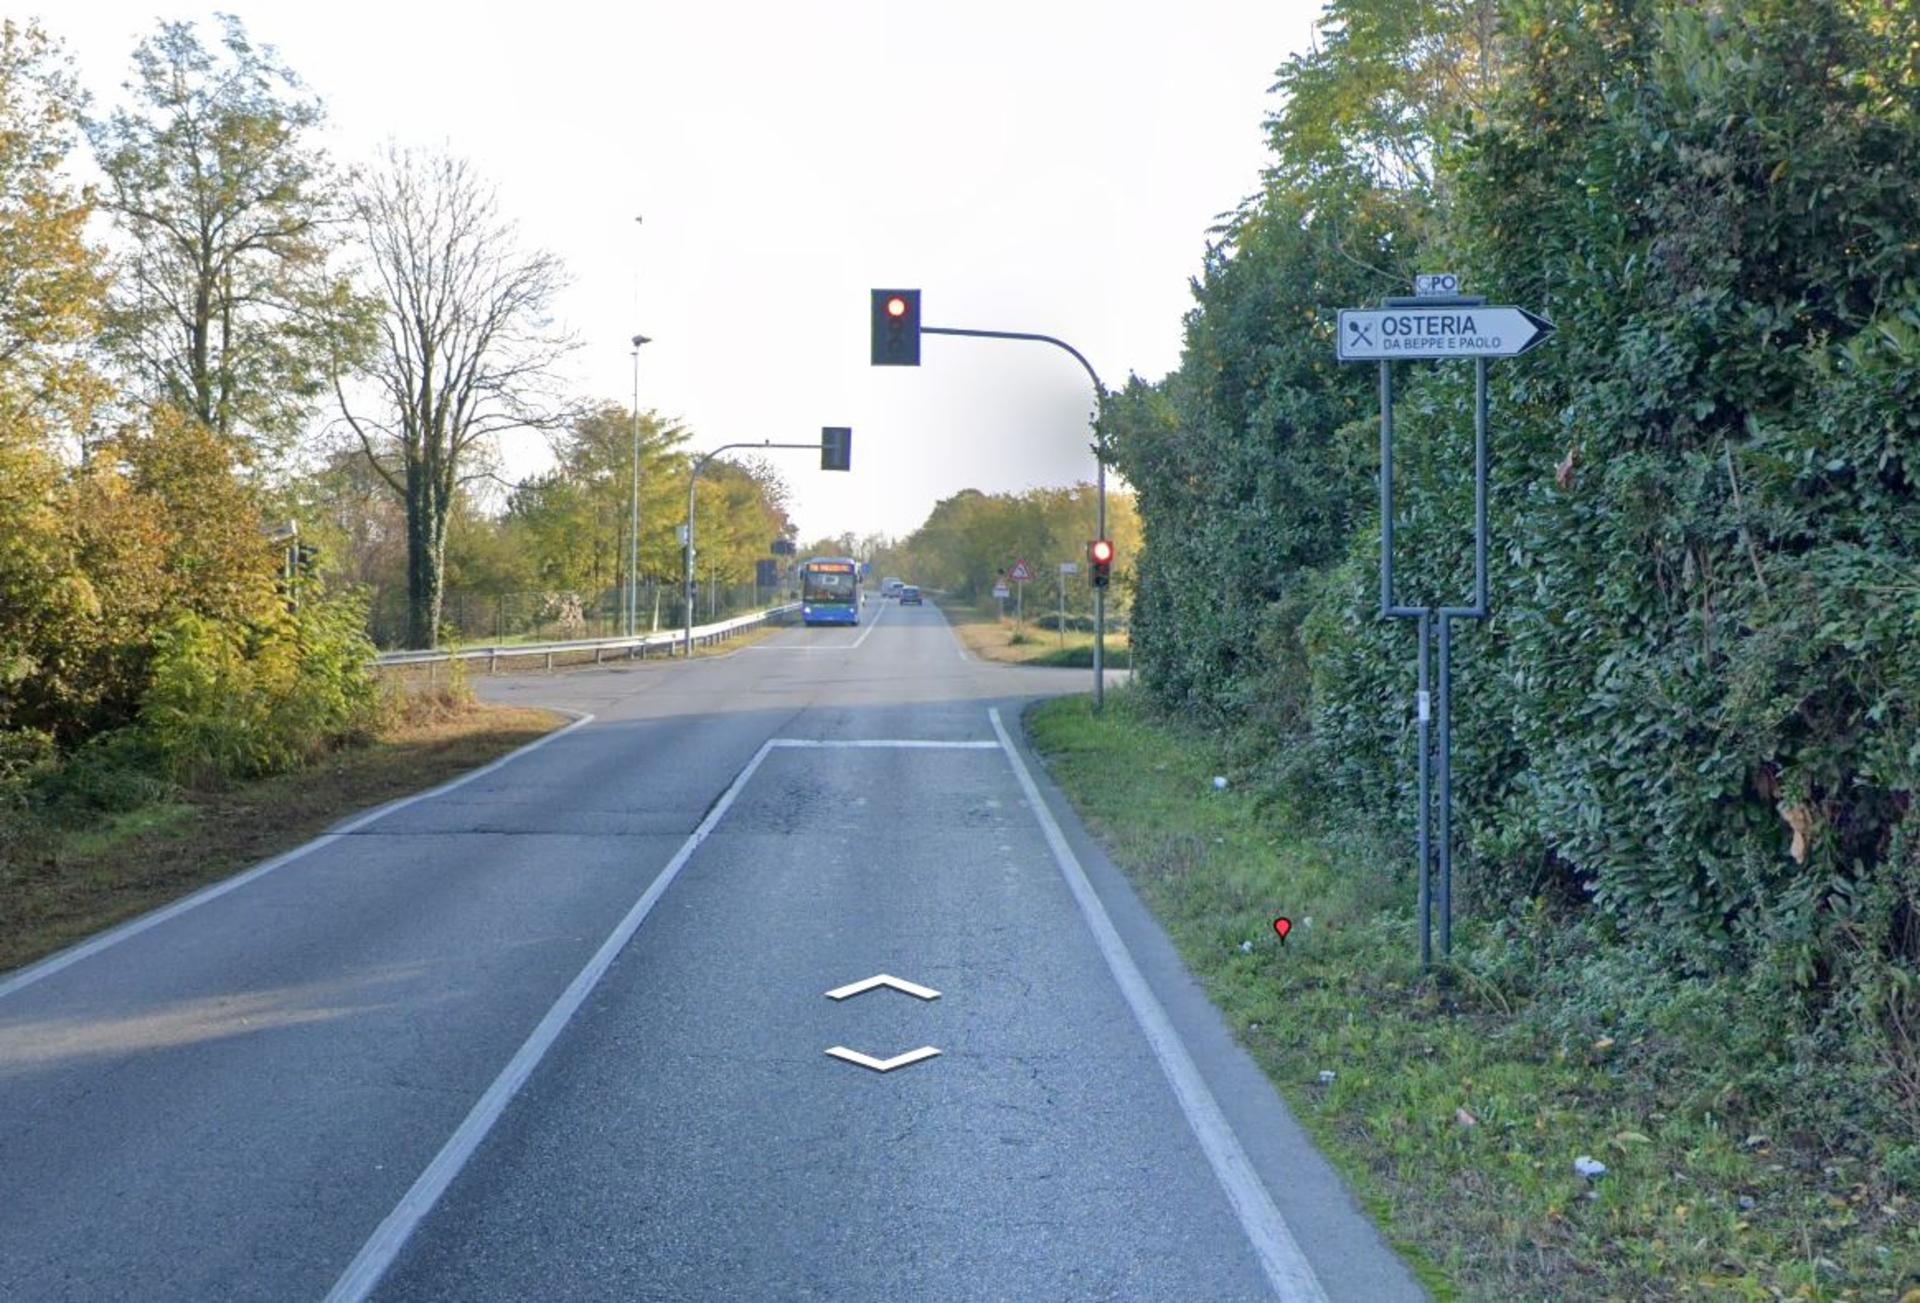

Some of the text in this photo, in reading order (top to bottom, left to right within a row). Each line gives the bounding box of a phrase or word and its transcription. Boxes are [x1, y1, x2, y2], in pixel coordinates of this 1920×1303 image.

[1382, 315, 1477, 336] OSTERIA
[1383, 336, 1501, 350] DA BEPPE E PAOLO
